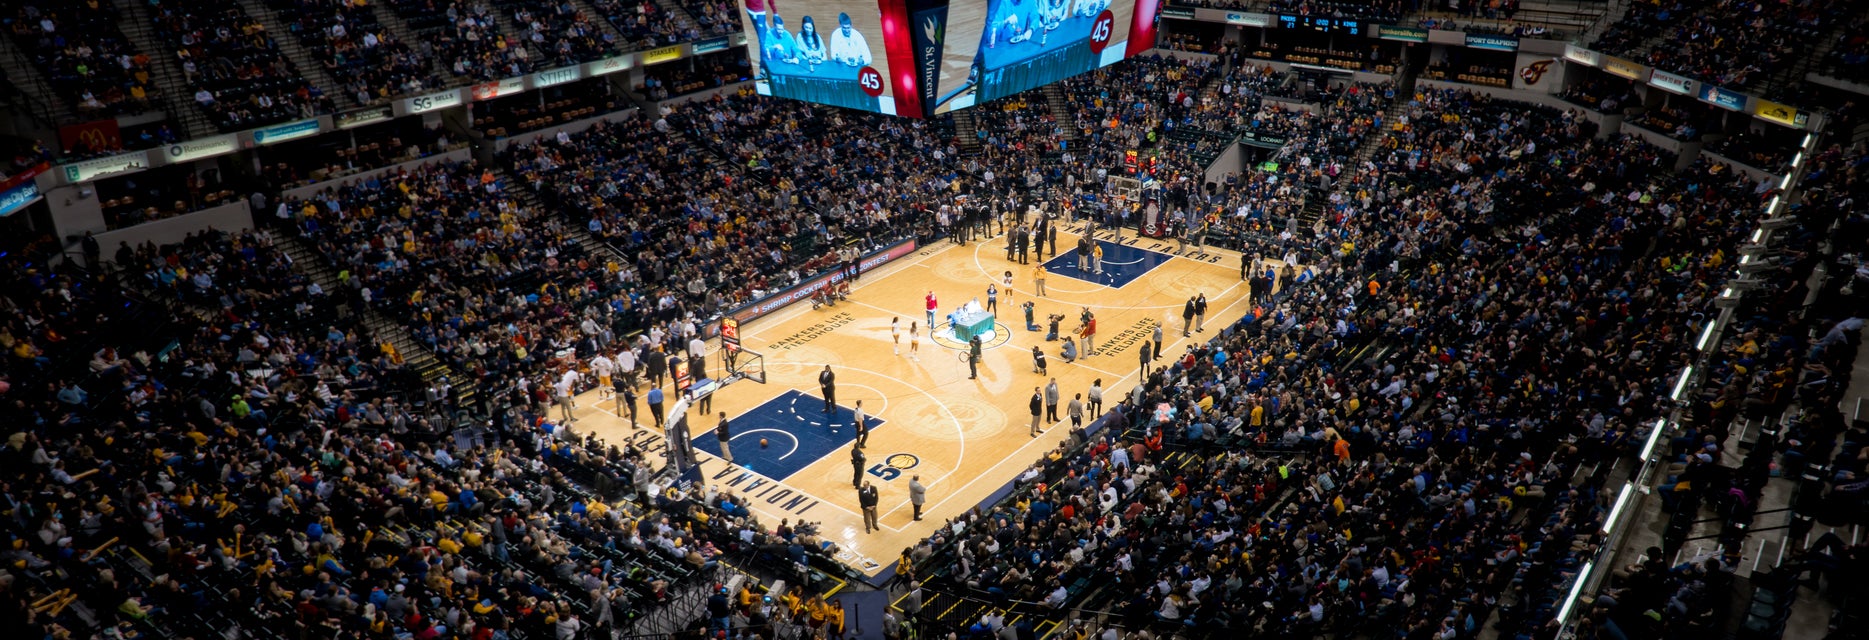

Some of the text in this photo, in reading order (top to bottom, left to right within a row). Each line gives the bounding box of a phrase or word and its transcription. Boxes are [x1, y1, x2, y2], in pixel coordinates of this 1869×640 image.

[1093, 19, 1111, 43] 45
[1380, 28, 1428, 38] bankerslife.com
[1466, 36, 1518, 47] SPORT GRAPHICS
[649, 47, 676, 57] STANLEY
[861, 72, 879, 90] 45
[926, 62, 935, 99] Vincent
[413, 93, 454, 111] SG SELLS
[1125, 156, 1137, 164] 24
[22, 184, 37, 197] Bank
[1064, 226, 1140, 246] INIANA
[761, 295, 792, 313] SHRIMP
[831, 266, 857, 284] EATIG
[723, 326, 736, 338] 24
[769, 311, 851, 350] BANKERS LIFE
[783, 317, 856, 350] FIELDHOUSE
[1093, 316, 1154, 357] BANKERS LIFE
[712, 465, 820, 515] INDIANA
